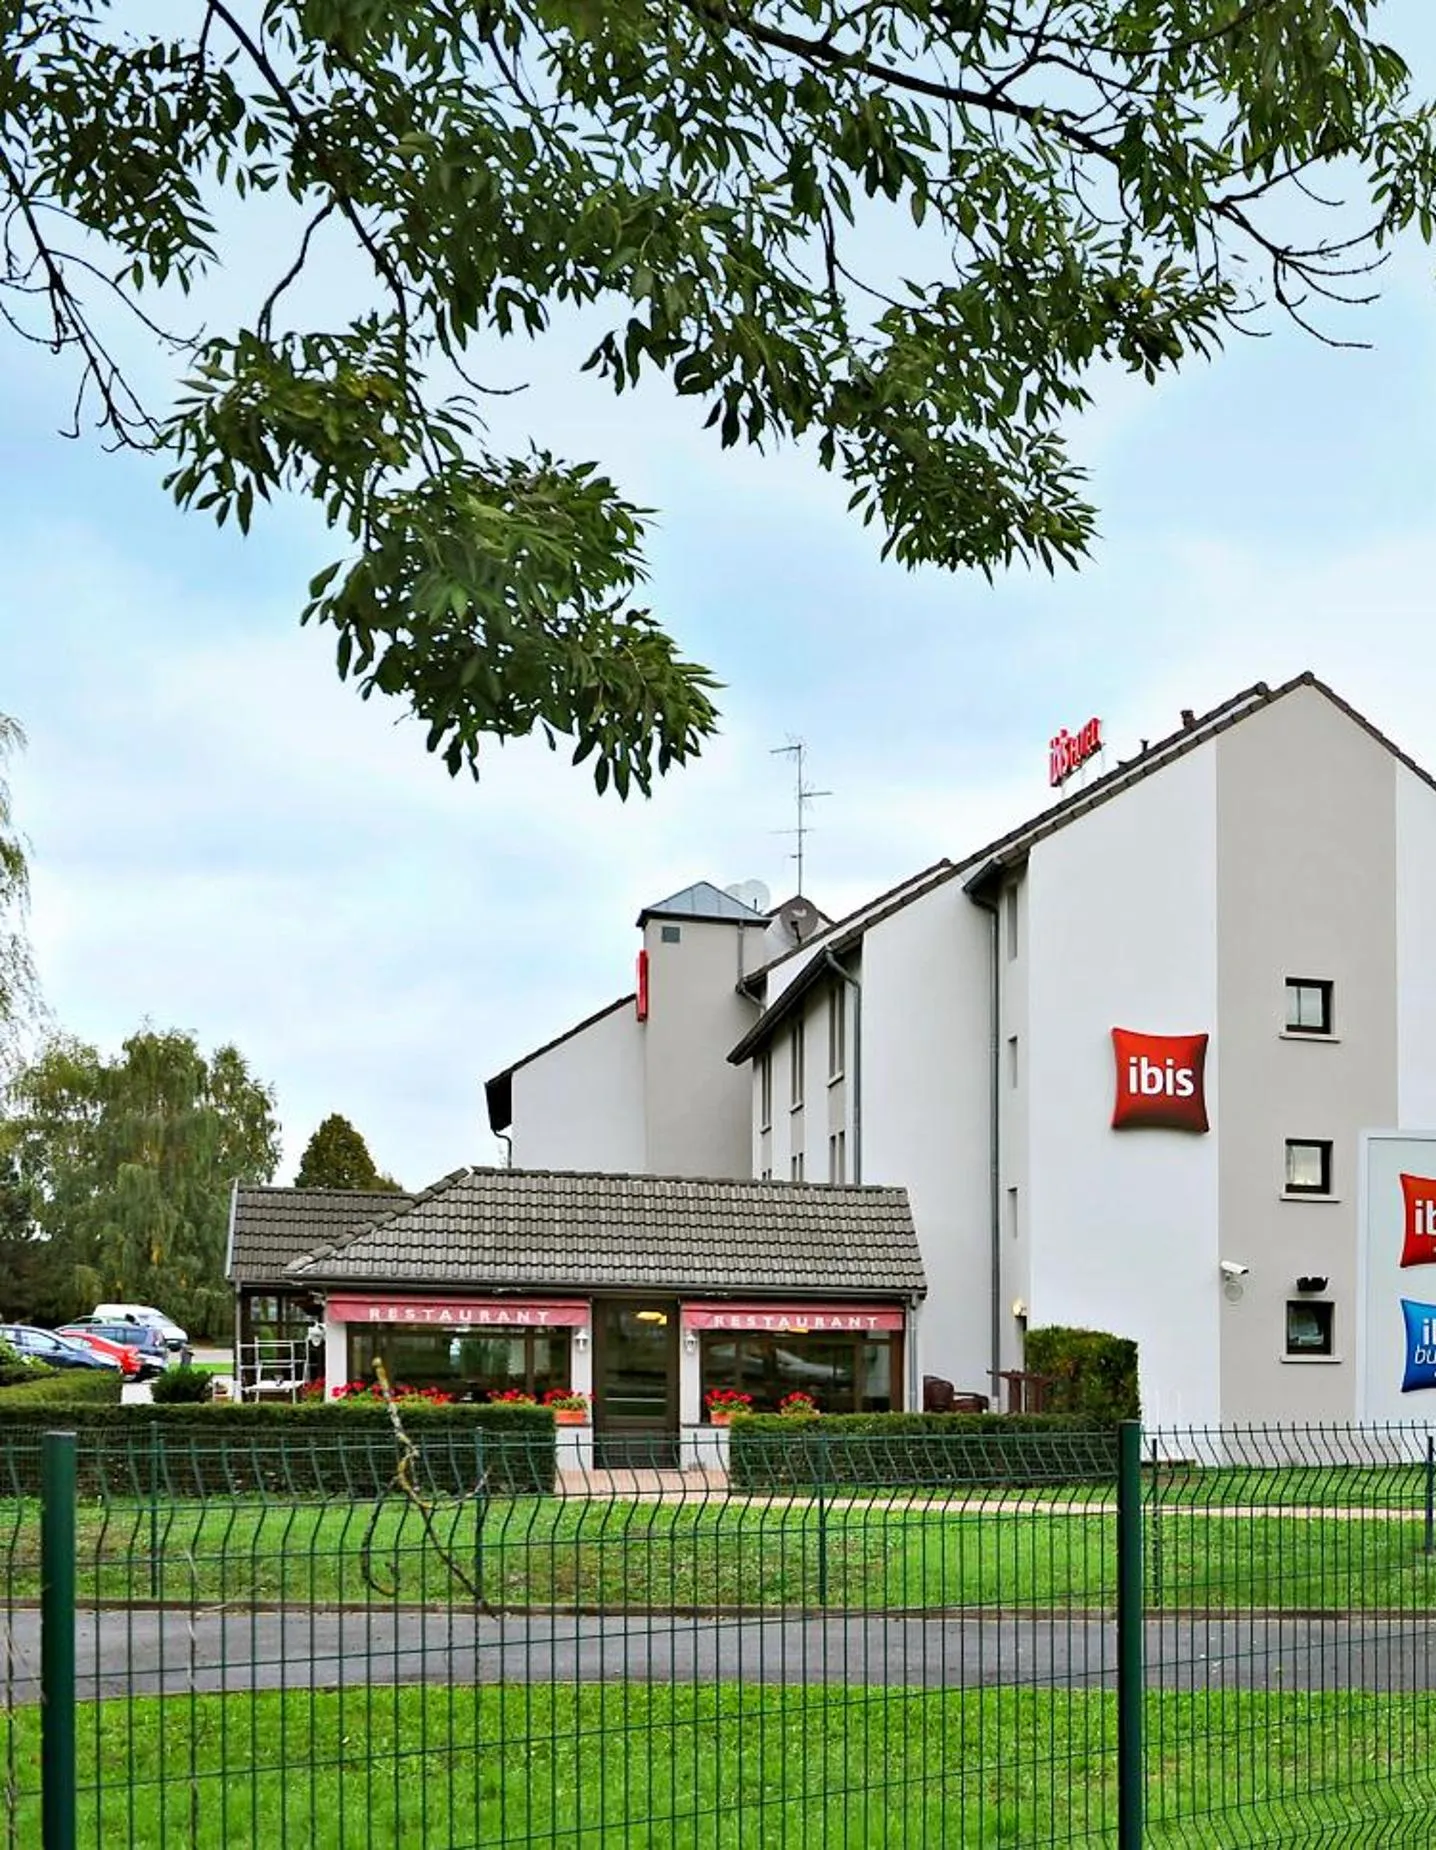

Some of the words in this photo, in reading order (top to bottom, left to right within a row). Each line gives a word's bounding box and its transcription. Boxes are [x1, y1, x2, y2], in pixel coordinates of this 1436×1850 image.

[1129, 1056, 1194, 1096] ibis
[369, 1308, 550, 1323] RESTAURANT
[714, 1315, 879, 1329] RESTAURANT
